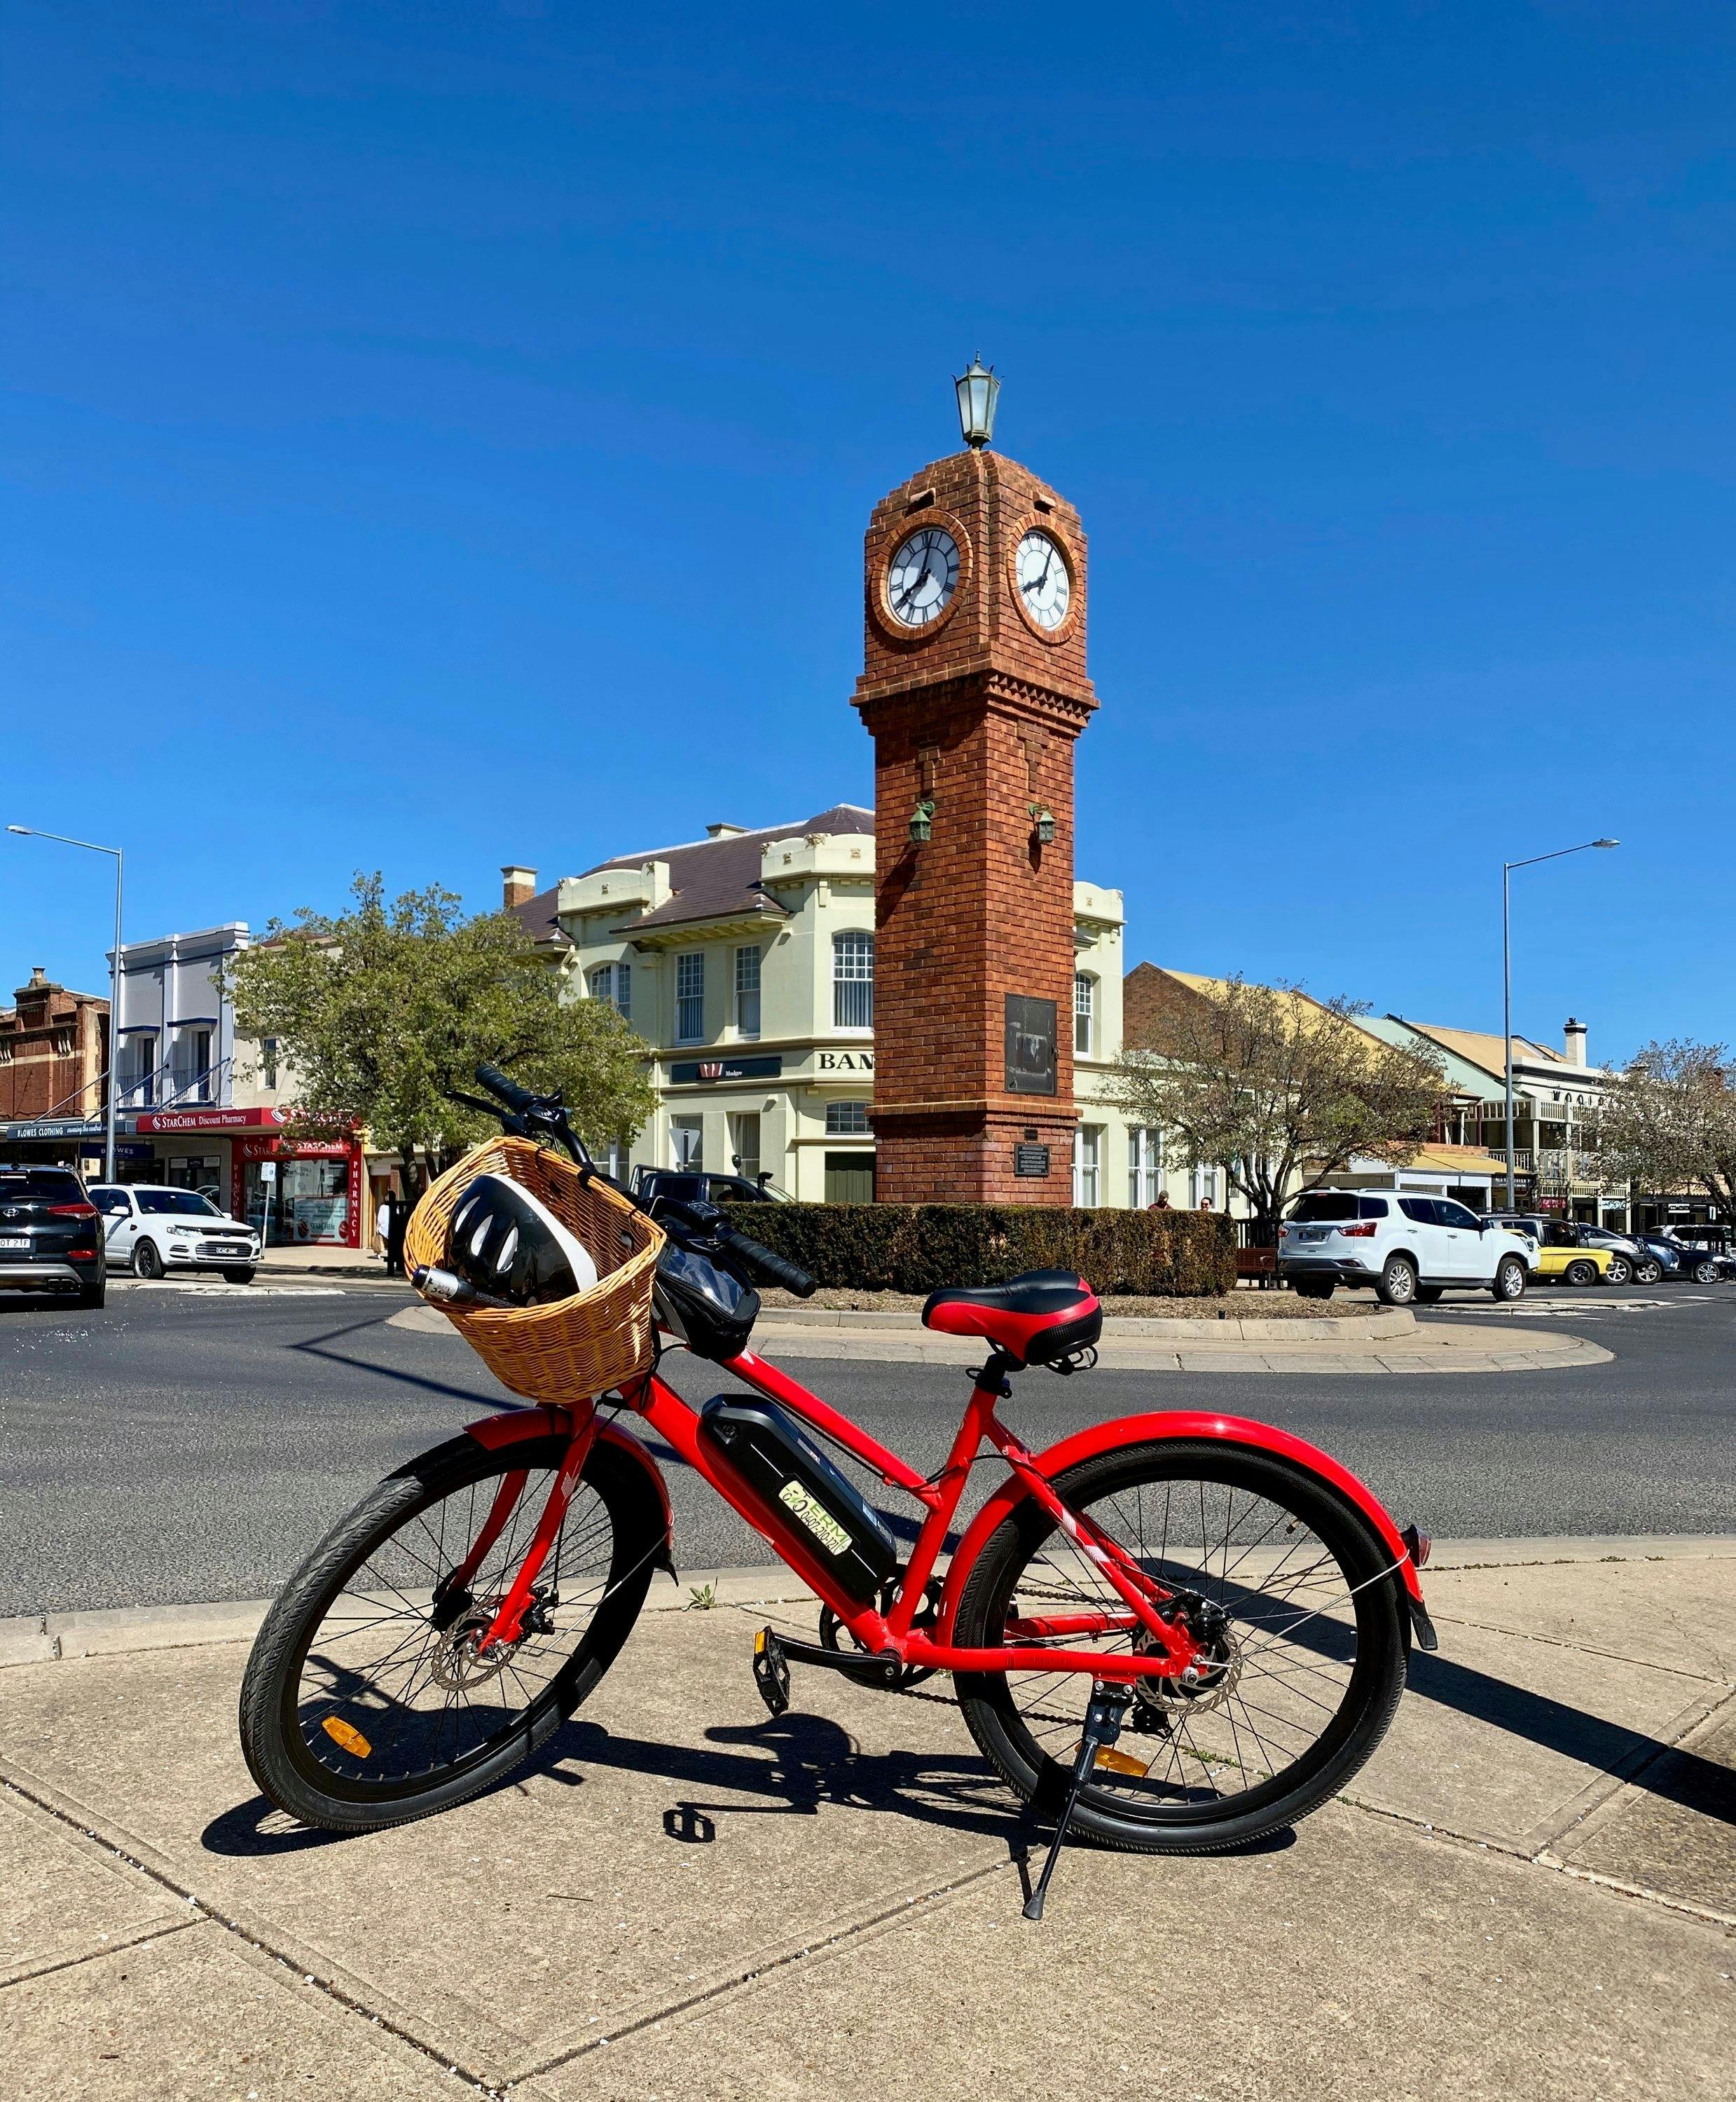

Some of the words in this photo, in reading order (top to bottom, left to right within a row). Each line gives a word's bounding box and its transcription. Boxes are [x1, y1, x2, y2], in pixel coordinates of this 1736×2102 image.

[199, 1115, 221, 1125] Discount
[221, 1114, 247, 1125] Pharmacy
[18, 1127, 36, 1138] BLOWES
[39, 1127, 64, 1136] CLOTHING
[800, 1511, 839, 1551] 0407-210-121
[810, 1503, 848, 1543] ERM
